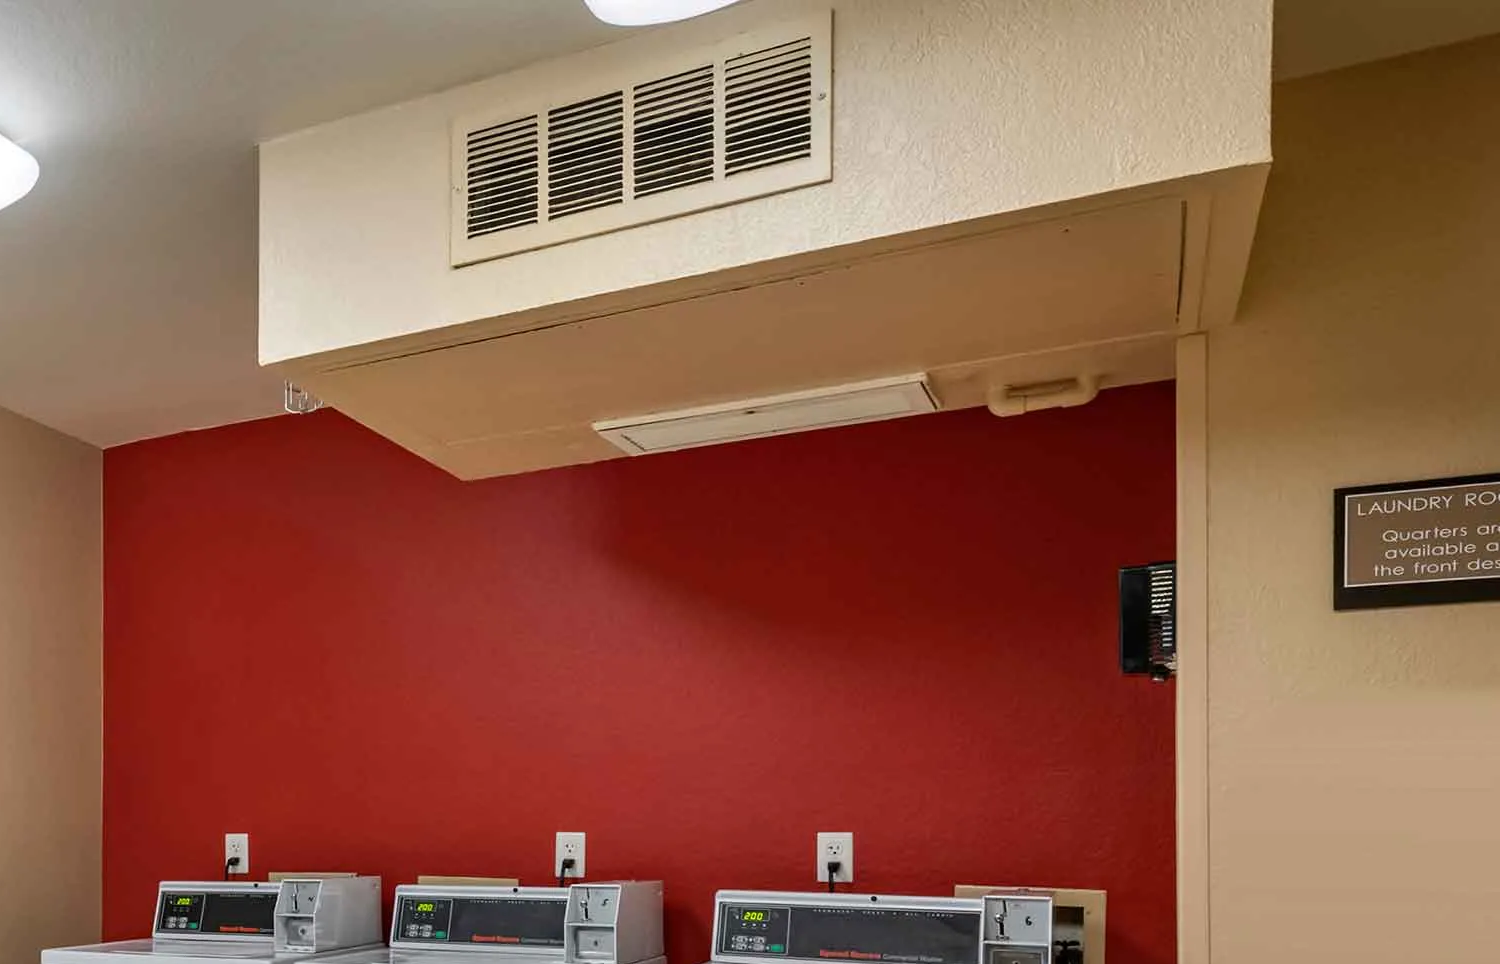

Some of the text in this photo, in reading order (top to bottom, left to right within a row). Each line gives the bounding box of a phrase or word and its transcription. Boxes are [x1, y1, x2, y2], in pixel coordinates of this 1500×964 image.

[1357, 491, 1500, 516] LAUNDRY RO
[1382, 524, 1500, 543] Quarters ar
[1385, 542, 1477, 560] available
[1374, 564, 1405, 577] the
[1414, 560, 1457, 575] front
[743, 912, 764, 921] 200
[1025, 916, 1033, 926] 6
